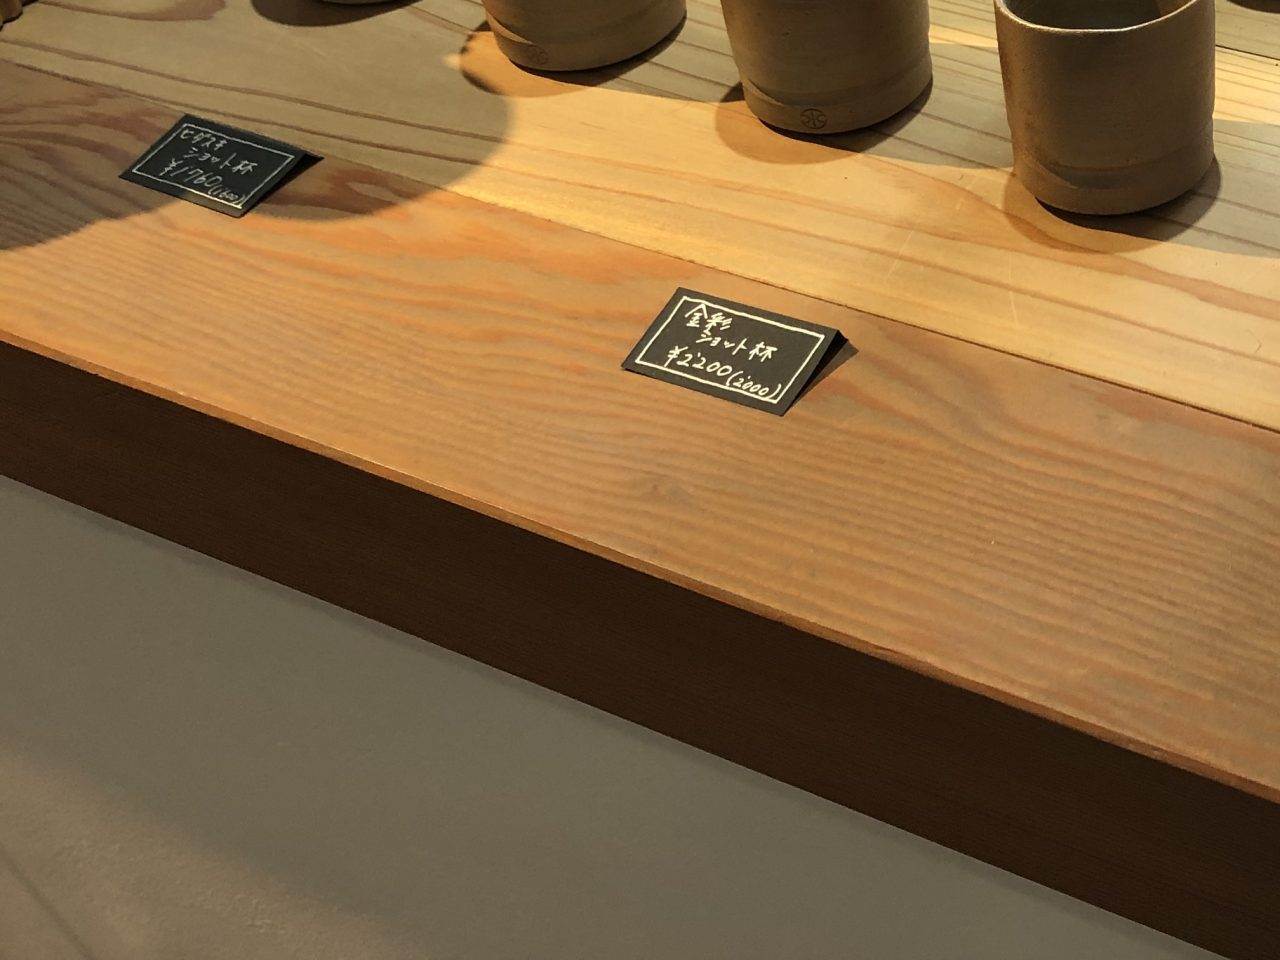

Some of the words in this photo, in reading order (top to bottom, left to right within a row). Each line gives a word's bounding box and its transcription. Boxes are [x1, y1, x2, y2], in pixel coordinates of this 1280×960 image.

[183, 146, 259, 175] ショット杯
[695, 329, 778, 362] ショット杯
